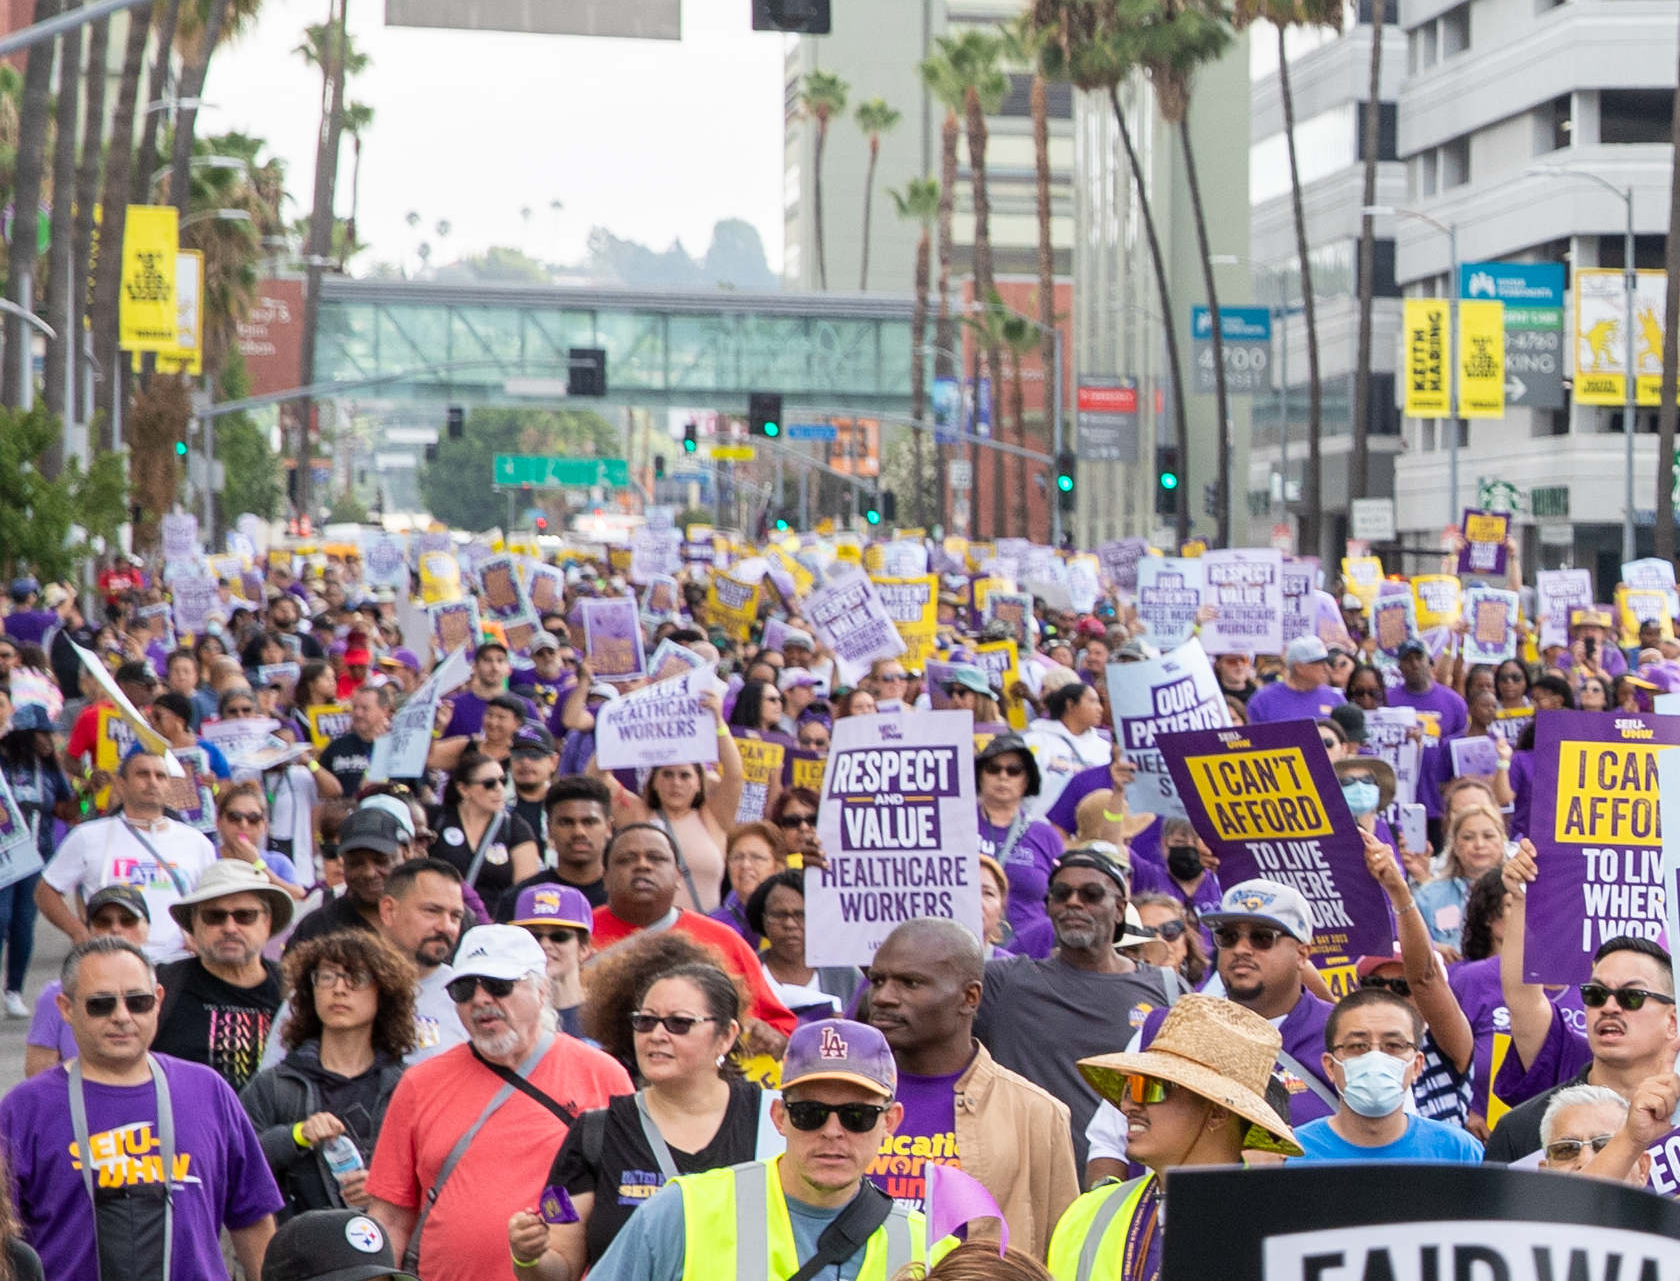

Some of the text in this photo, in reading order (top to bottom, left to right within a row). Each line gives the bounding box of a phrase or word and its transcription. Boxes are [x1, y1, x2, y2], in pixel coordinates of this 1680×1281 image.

[832, 753, 953, 792] RESPECT
[845, 807, 937, 848] VALUE
[821, 857, 968, 887] HEALTHCARE
[840, 893, 953, 921] WORKERS
